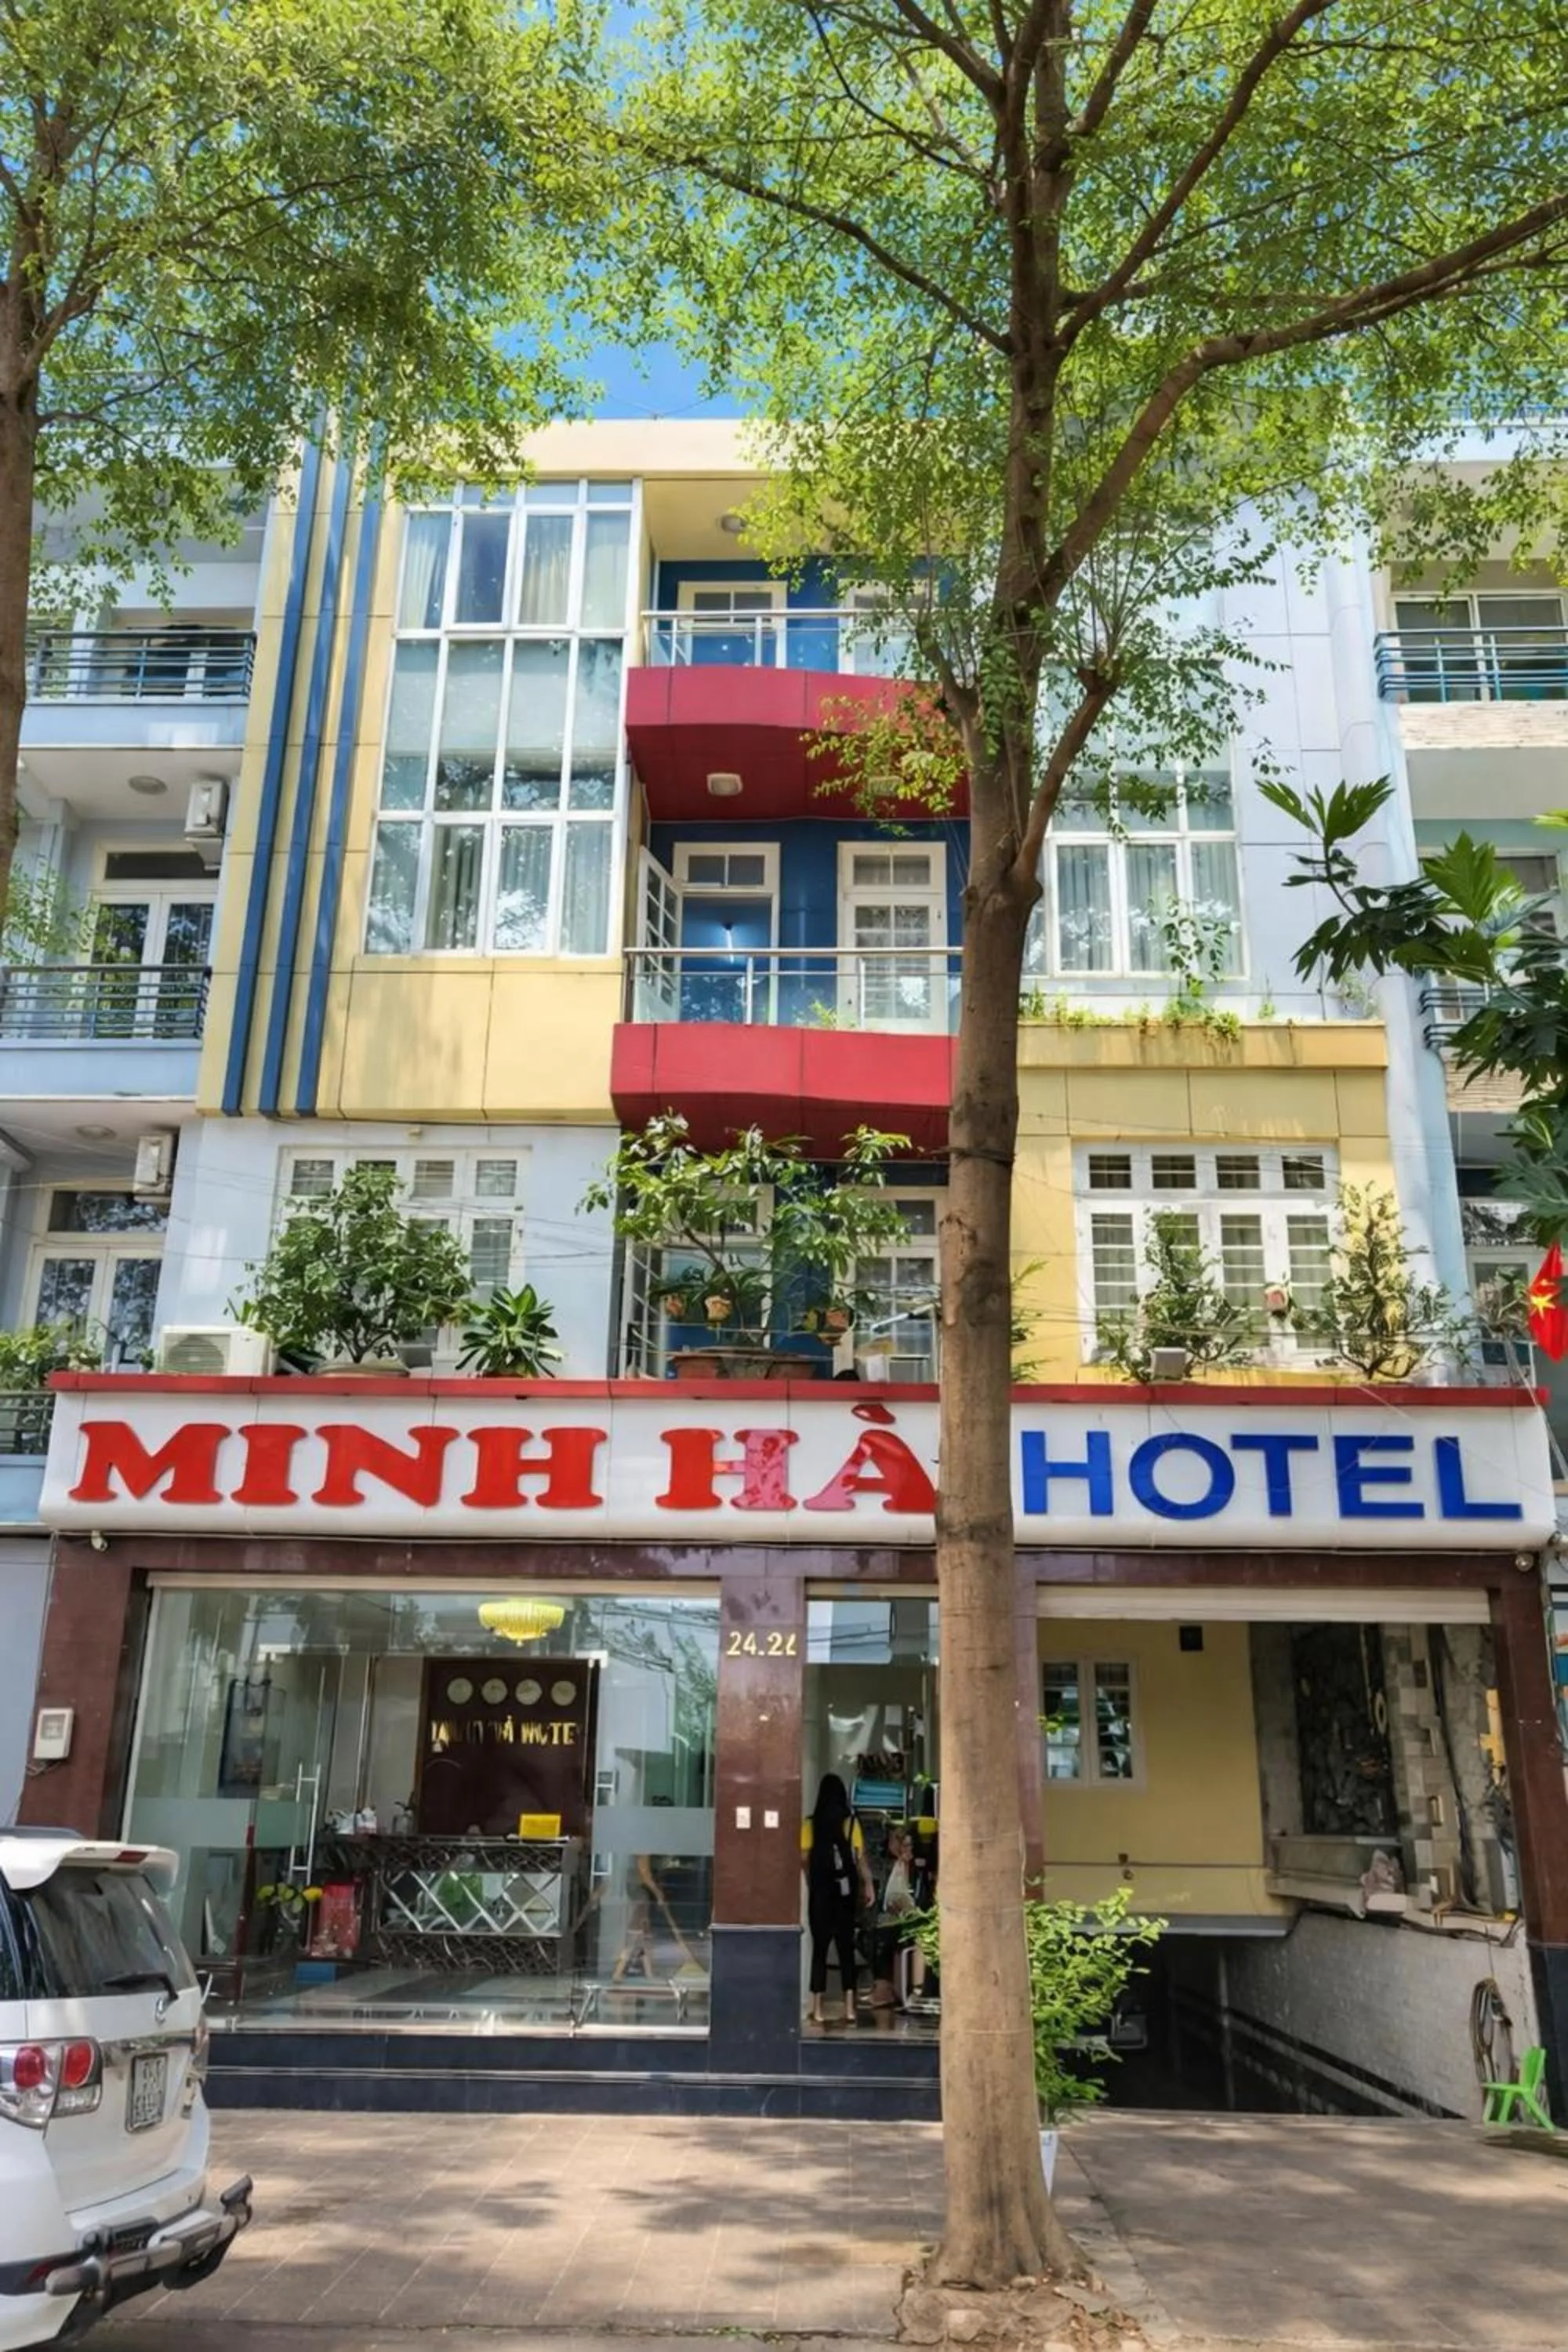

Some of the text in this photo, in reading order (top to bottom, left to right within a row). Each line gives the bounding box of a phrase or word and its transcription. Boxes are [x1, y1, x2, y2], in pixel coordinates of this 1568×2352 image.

[68, 1403, 1522, 1519] MINH HÀ HOTEL
